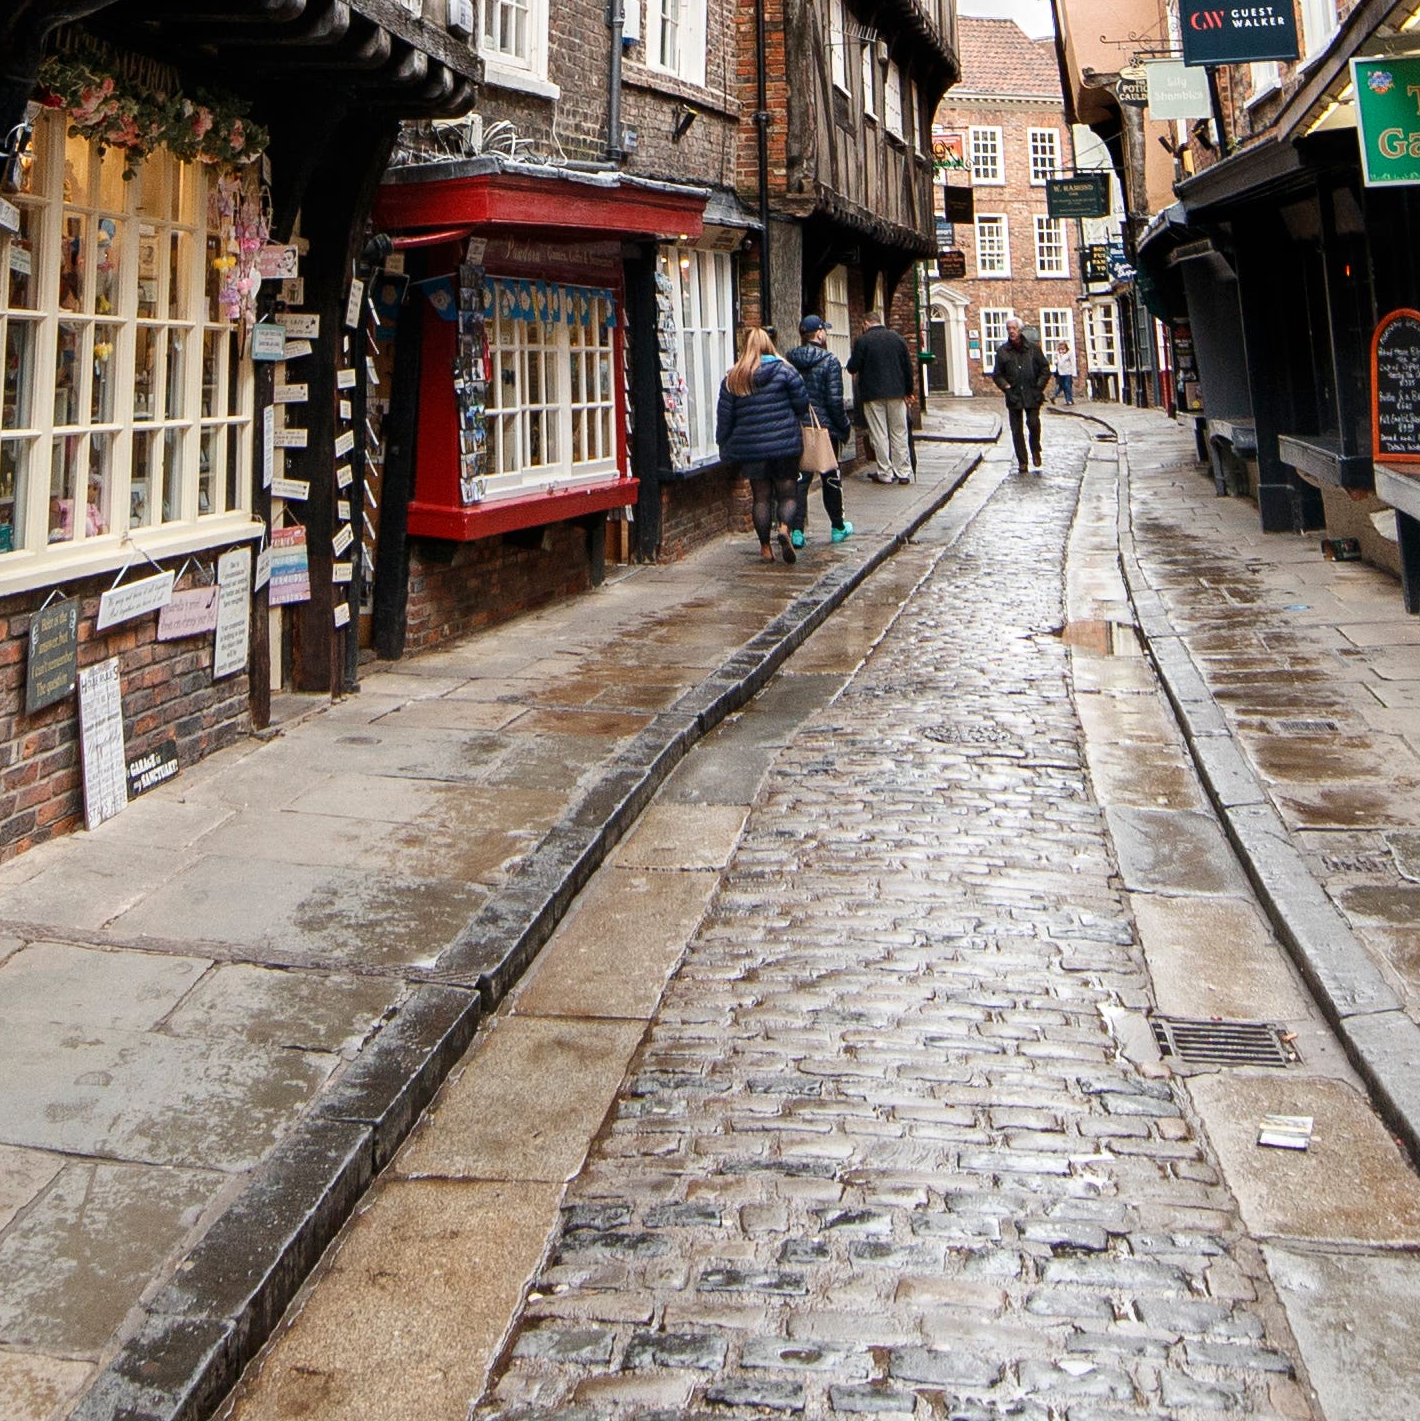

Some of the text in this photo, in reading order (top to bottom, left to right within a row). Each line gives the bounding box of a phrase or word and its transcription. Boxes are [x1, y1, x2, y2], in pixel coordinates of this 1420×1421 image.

[1231, 7, 1273, 18] GUEST
[1232, 17, 1285, 28] WALKER
[1167, 76, 1188, 89] Lily
[1122, 84, 1148, 93] POTIO
[1154, 90, 1204, 101] Shambles
